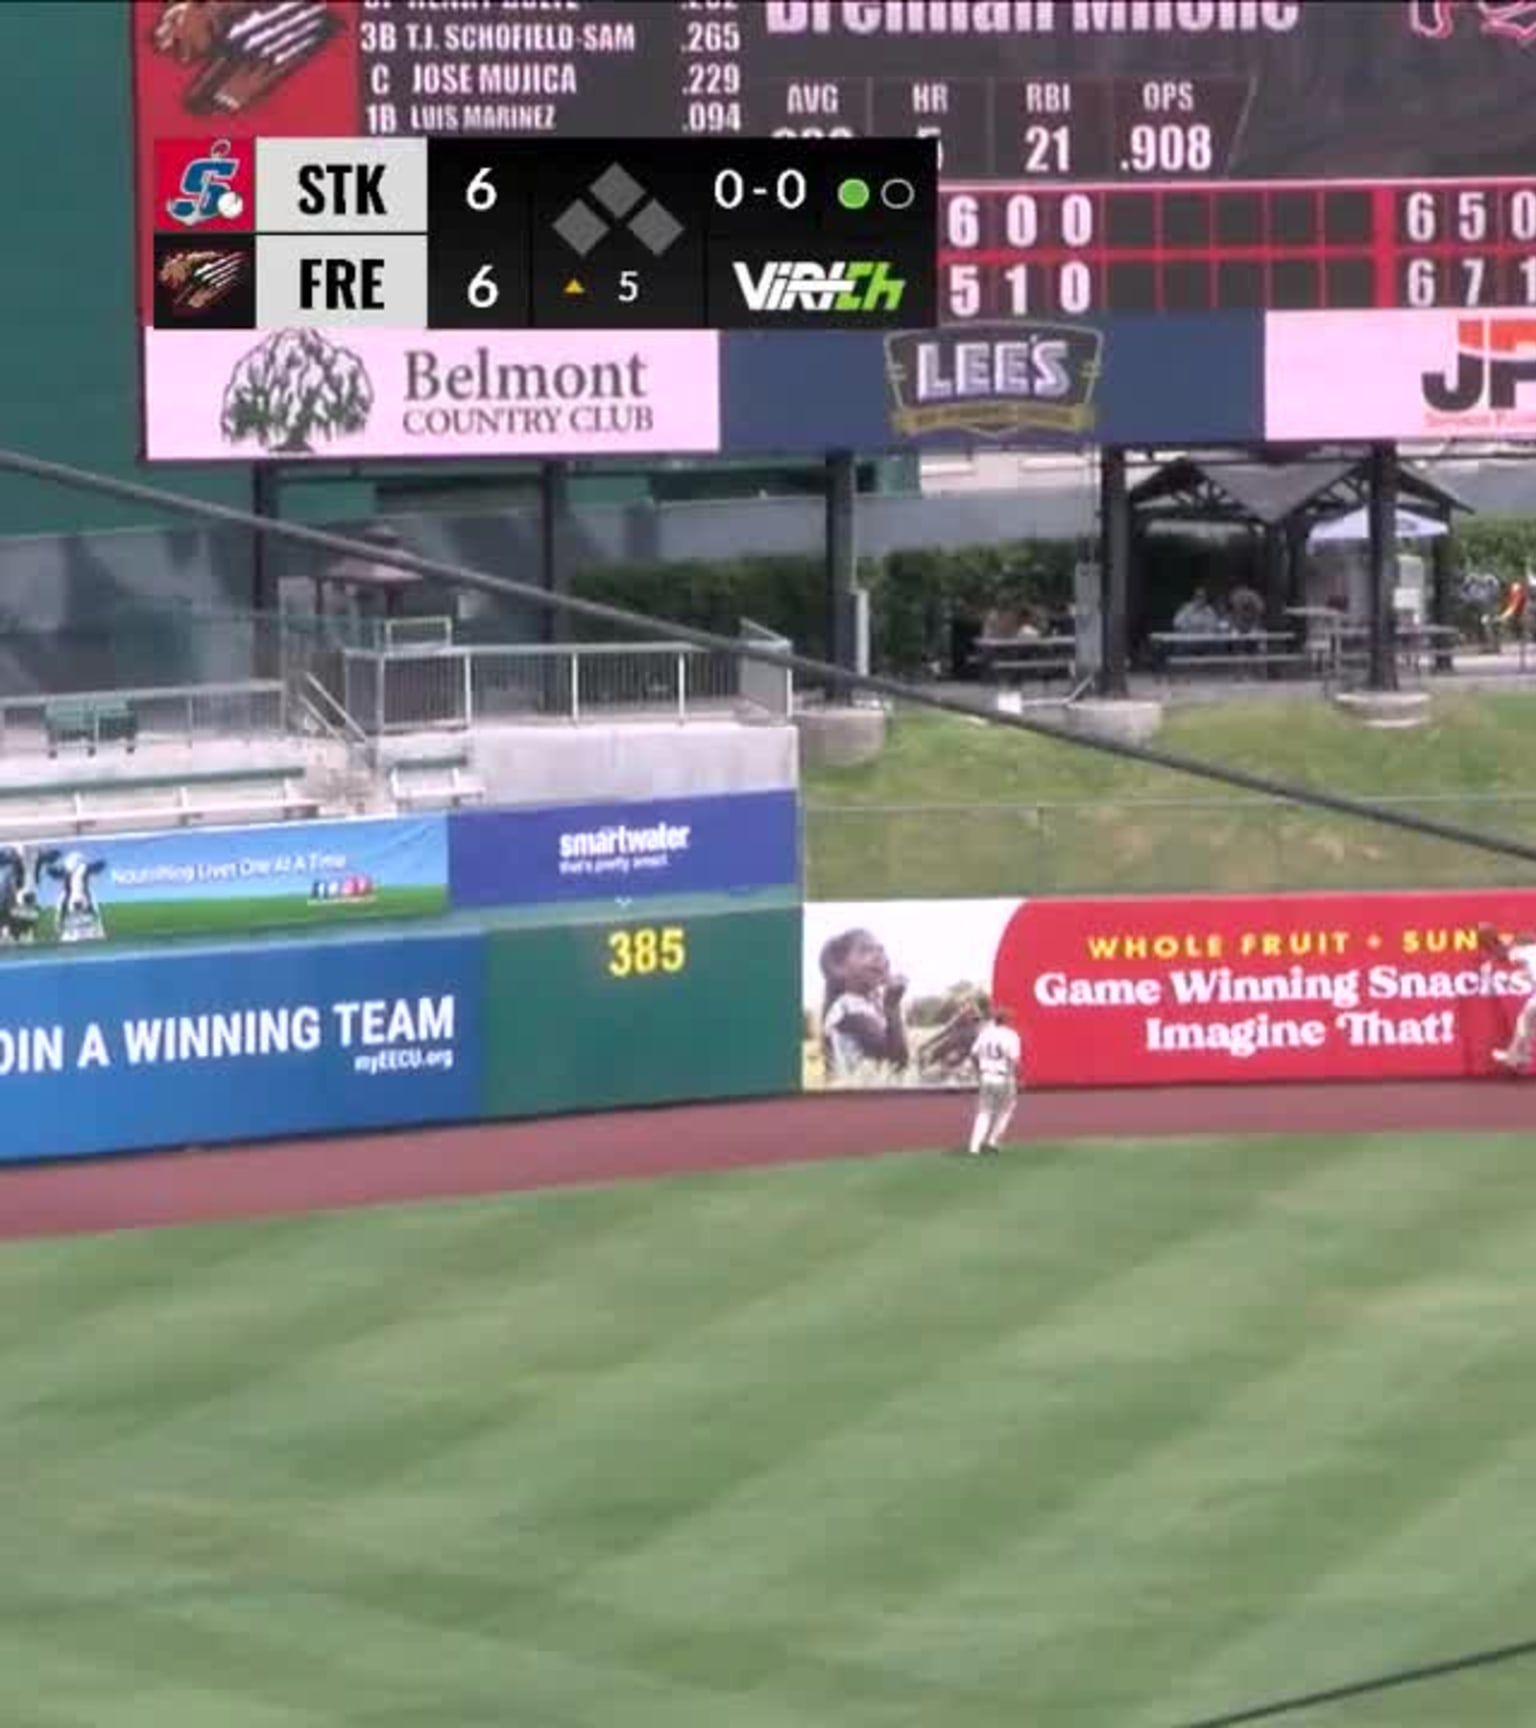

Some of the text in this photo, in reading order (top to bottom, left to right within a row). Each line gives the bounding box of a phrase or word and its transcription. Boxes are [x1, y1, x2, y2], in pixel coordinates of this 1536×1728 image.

[360, 21, 741, 51] 3B T.J. SCHOFIELD-SAM .265
[370, 62, 740, 95] C JOSE MUJICA .229
[787, 81, 1194, 114] AVG HR RBI OPS
[366, 101, 741, 134] 1B LUIS MARINEZ .094
[1025, 124, 1213, 173] 21 .908
[948, 195, 980, 248] 6
[1007, 194, 1038, 248] 0
[1062, 193, 1093, 247] 0
[1407, 191, 1436, 242] 6
[1458, 190, 1487, 240] 5
[950, 265, 981, 318] 5
[1005, 263, 1028, 316] 1
[1060, 260, 1091, 314] 0
[1407, 258, 1436, 308] 6
[1461, 258, 1487, 307] 7
[403, 346, 650, 401] Belmont
[916, 334, 1070, 402] LEE'S
[402, 403, 654, 437] COUNTRY CLUB
[559, 820, 691, 859] smartwater
[608, 926, 686, 978] 385
[1088, 932, 1224, 961] WHOLE
[1240, 930, 1349, 957] FRUIT
[1034, 965, 1534, 1008] Game Winning Snacks
[77, 1021, 111, 1070] A
[123, 1007, 321, 1064] WINNING
[332, 994, 455, 1049] TEAM
[1146, 1010, 1455, 1057] Imagine That!
[354, 1047, 454, 1076] myEECU.org
